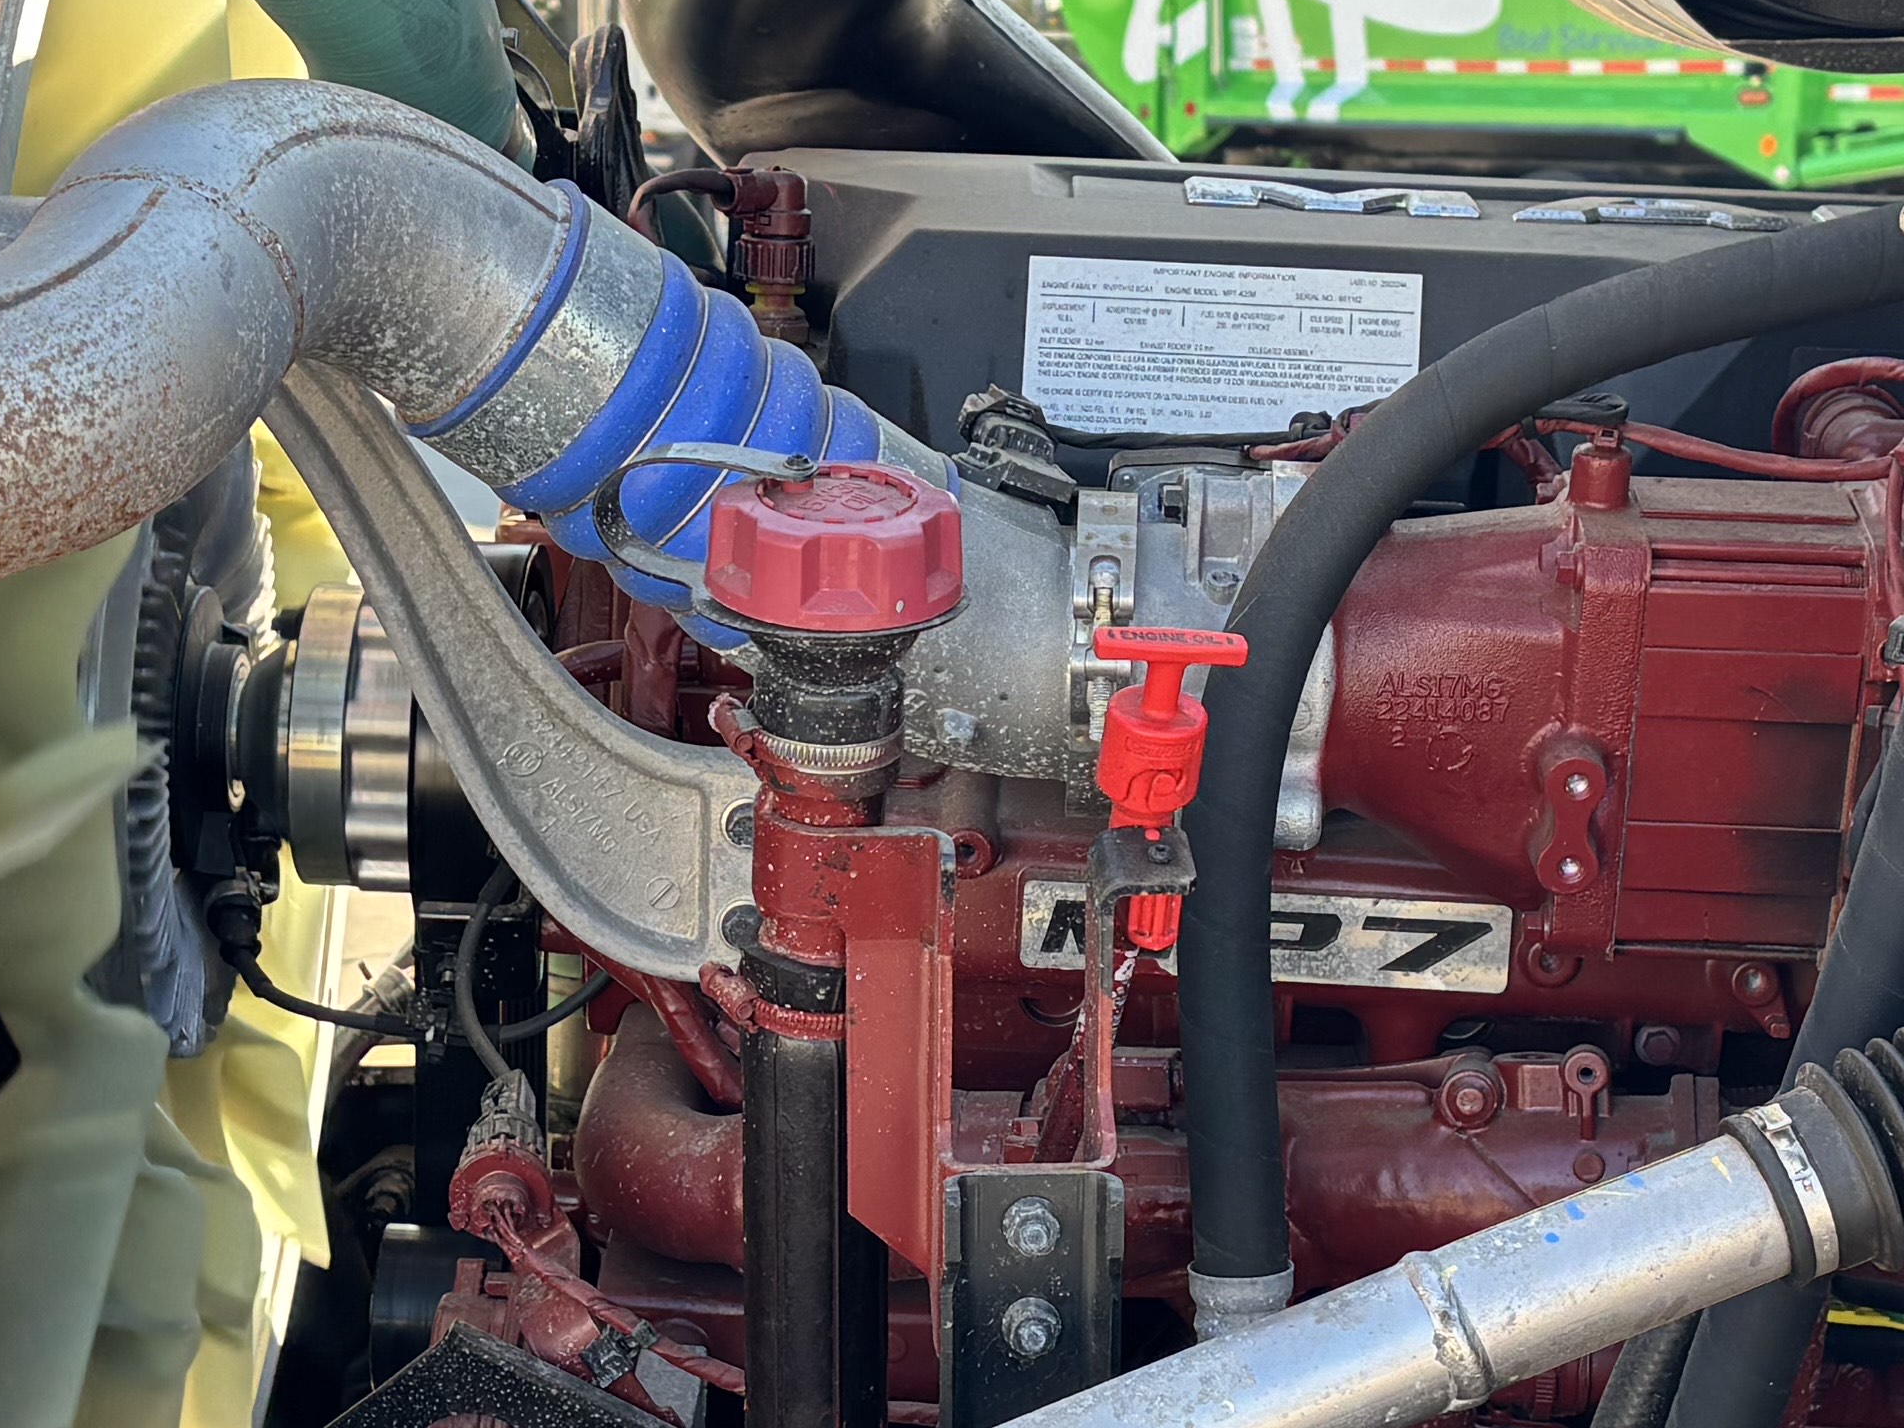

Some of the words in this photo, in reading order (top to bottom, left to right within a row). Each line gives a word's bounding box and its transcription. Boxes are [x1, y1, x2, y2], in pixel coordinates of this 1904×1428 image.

[1153, 267, 1201, 277] IMPORTANT
[1203, 269, 1235, 279] ENGINE
[1238, 273, 1296, 282] INFORMATION
[1041, 281, 1068, 289] ENGINE
[1164, 286, 1192, 295] ENGINE
[1194, 287, 1218, 296] MODEL
[840, 492, 887, 511] OIL
[1120, 630, 1186, 643] ENGINE
[1192, 633, 1223, 646] OIL
[1377, 698, 1509, 722] 22414087
[623, 802, 662, 847] USA
